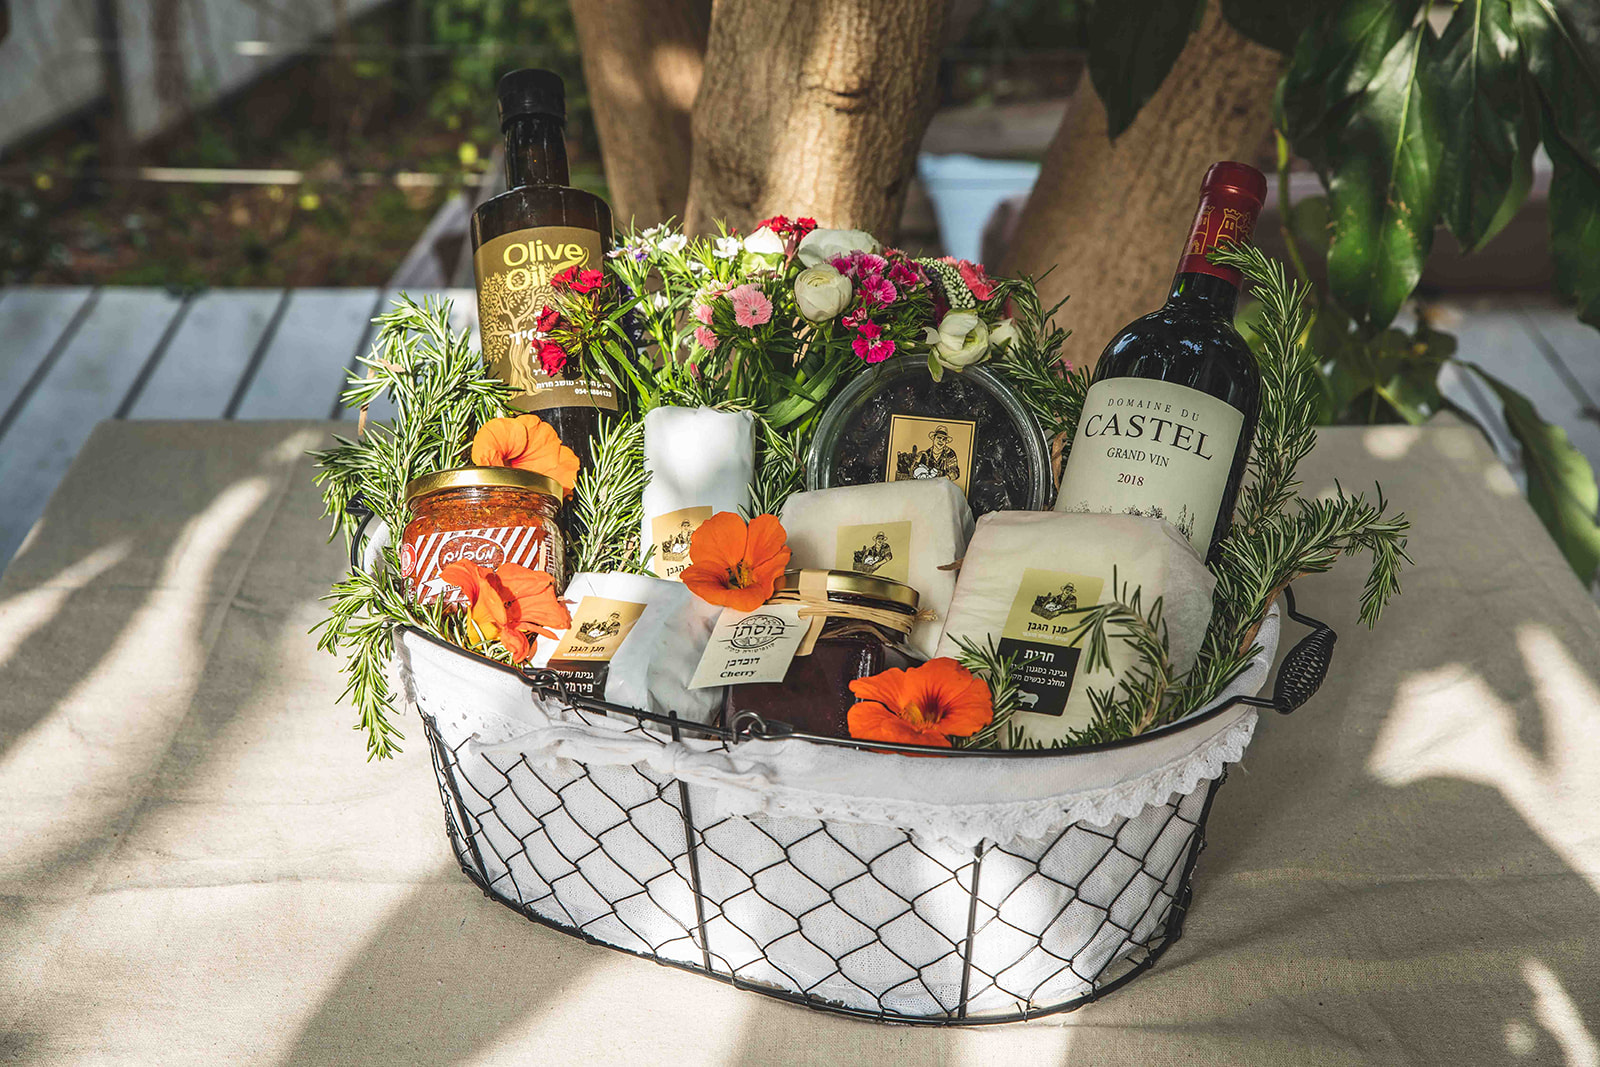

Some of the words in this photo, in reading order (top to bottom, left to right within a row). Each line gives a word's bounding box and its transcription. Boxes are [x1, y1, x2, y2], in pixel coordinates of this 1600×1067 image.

[503, 239, 585, 267] Olive
[506, 267, 548, 292] Oil
[1107, 398, 1172, 414] DOMAINE
[1181, 408, 1201, 422] DU
[1085, 413, 1213, 461] CASTEL
[1106, 447, 1146, 461] GRAND
[1149, 454, 1170, 468] VIN
[1117, 473, 1145, 487] 2018
[732, 625, 785, 640] בוסתן
[1027, 621, 1048, 632] הגבן
[725, 657, 760, 669] דובדבן
[1024, 649, 1055, 663] חרית
[720, 670, 757, 679] Cherry
[1024, 675, 1046, 685] כבשים
[1049, 668, 1068, 678] גבינה
[553, 681, 593, 693] פירמיה
[1047, 677, 1066, 688] מחלב
